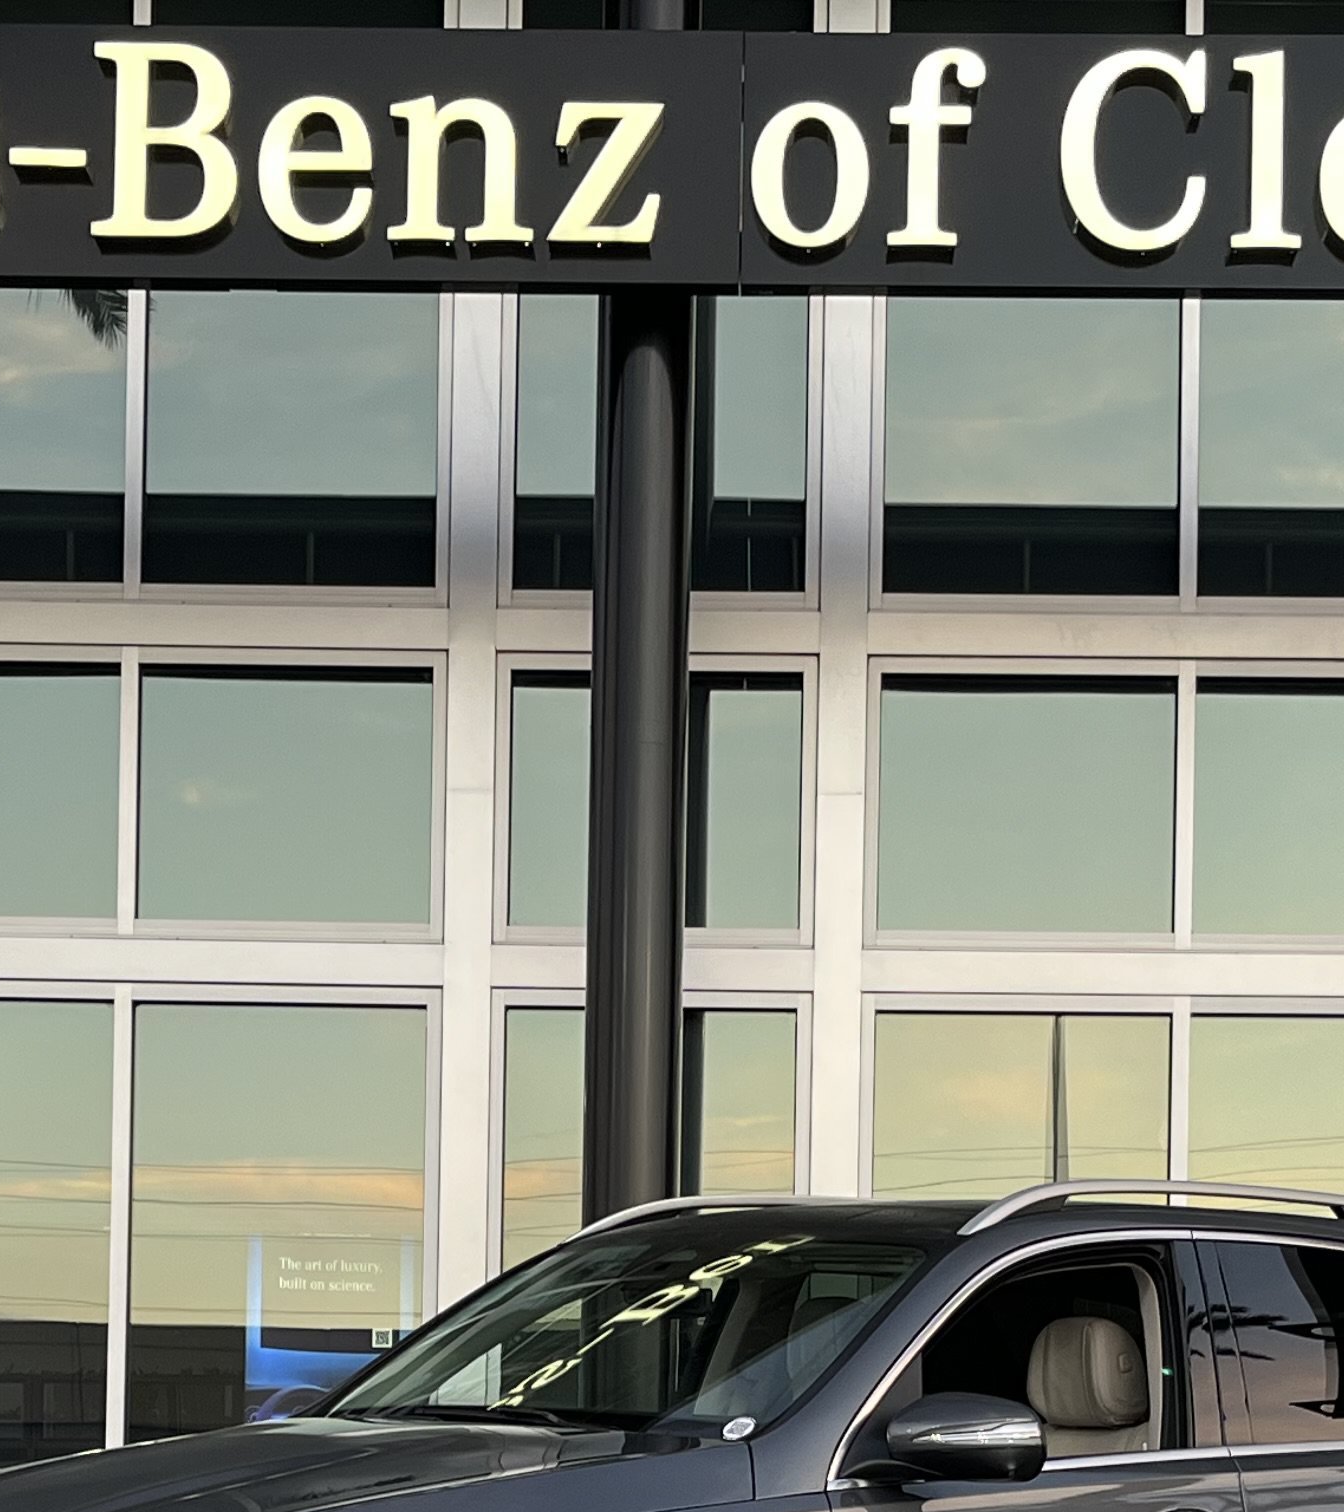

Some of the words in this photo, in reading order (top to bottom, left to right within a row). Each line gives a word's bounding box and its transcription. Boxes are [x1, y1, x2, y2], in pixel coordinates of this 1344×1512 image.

[752, 47, 987, 249] of
[279, 1256, 302, 1271] The
[305, 1260, 322, 1272] art
[325, 1259, 338, 1272] of
[279, 1276, 307, 1290] built
[310, 1280, 325, 1291] on
[328, 1279, 376, 1292] science.
